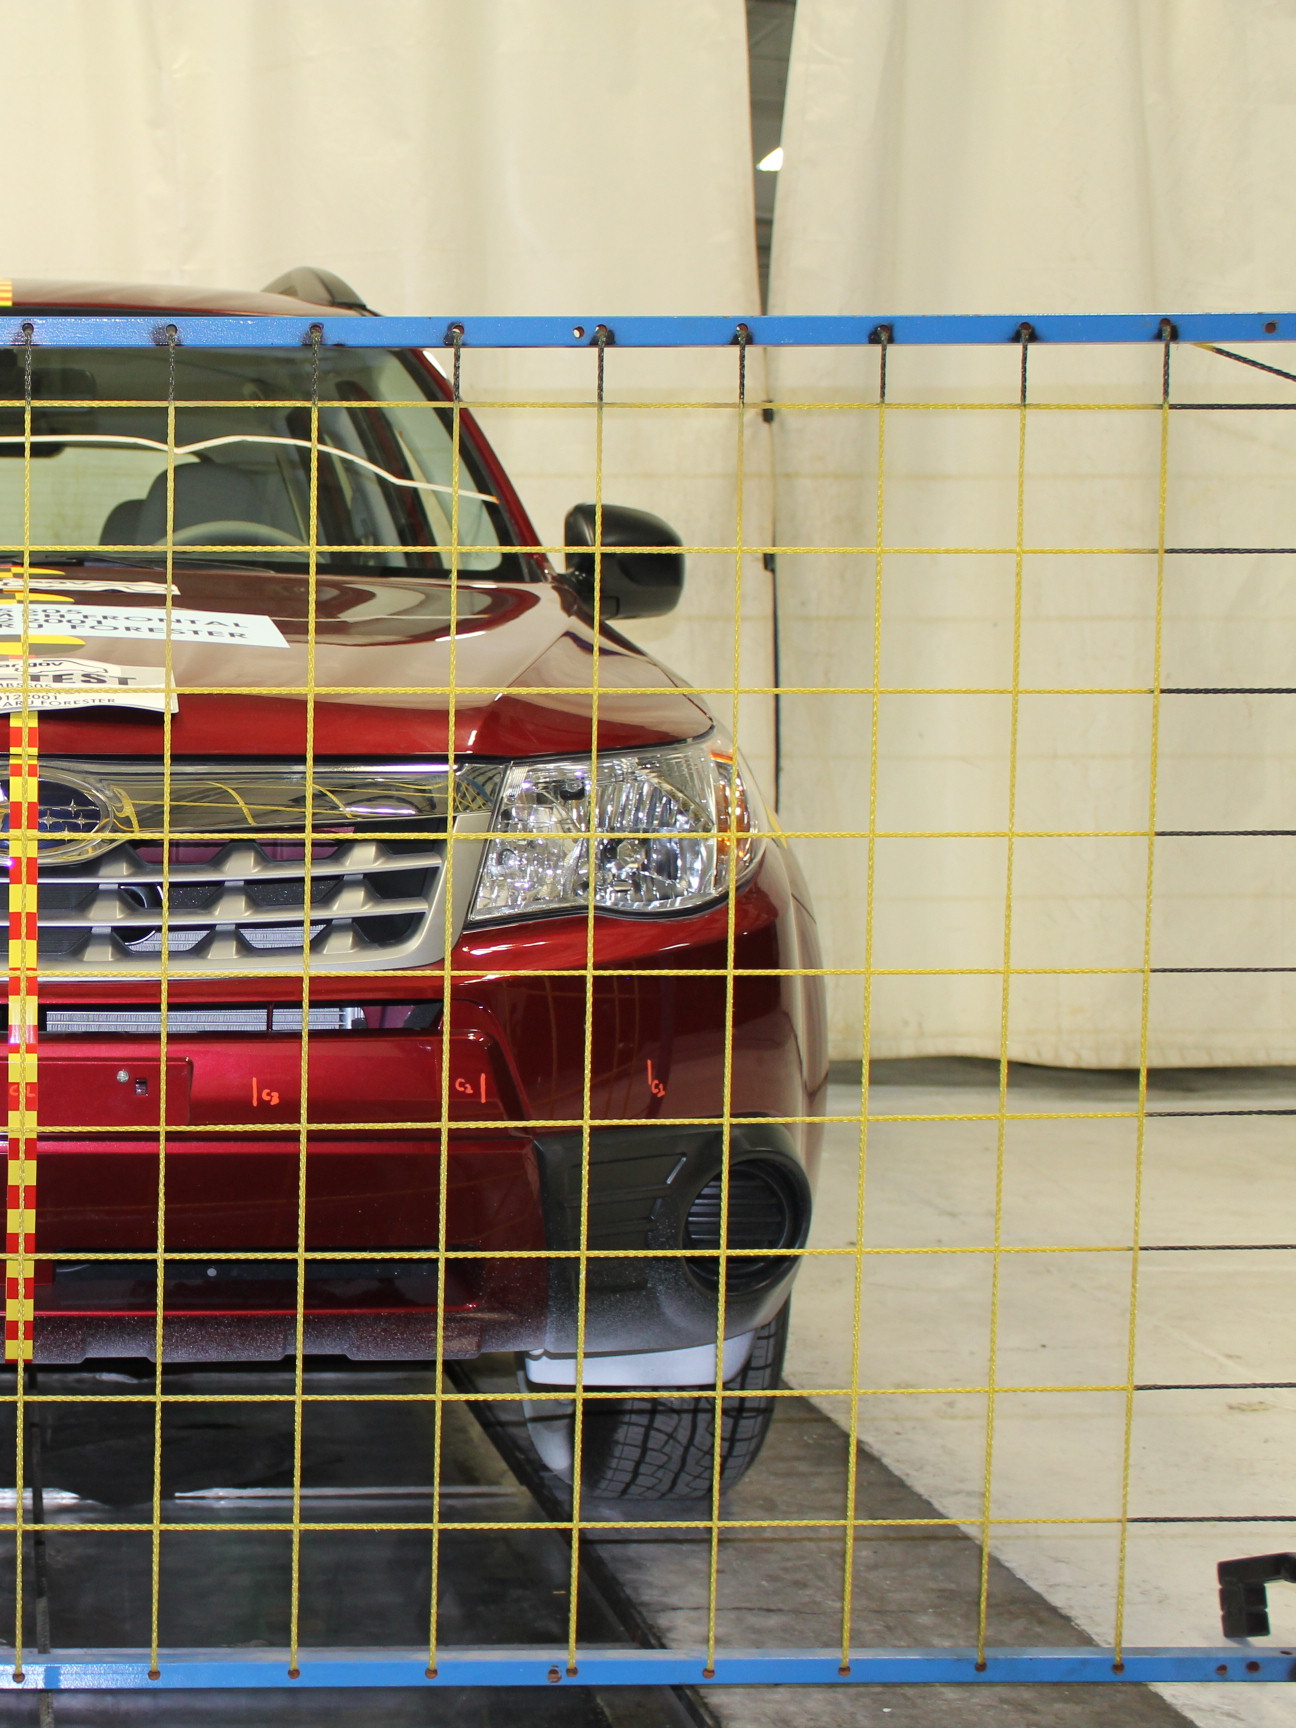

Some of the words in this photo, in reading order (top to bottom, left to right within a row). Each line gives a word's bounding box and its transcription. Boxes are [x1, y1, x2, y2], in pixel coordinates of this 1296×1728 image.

[82, 613, 249, 628] FRONTAL
[70, 624, 249, 639] FORESTER
[40, 698, 117, 706] FORESTER
